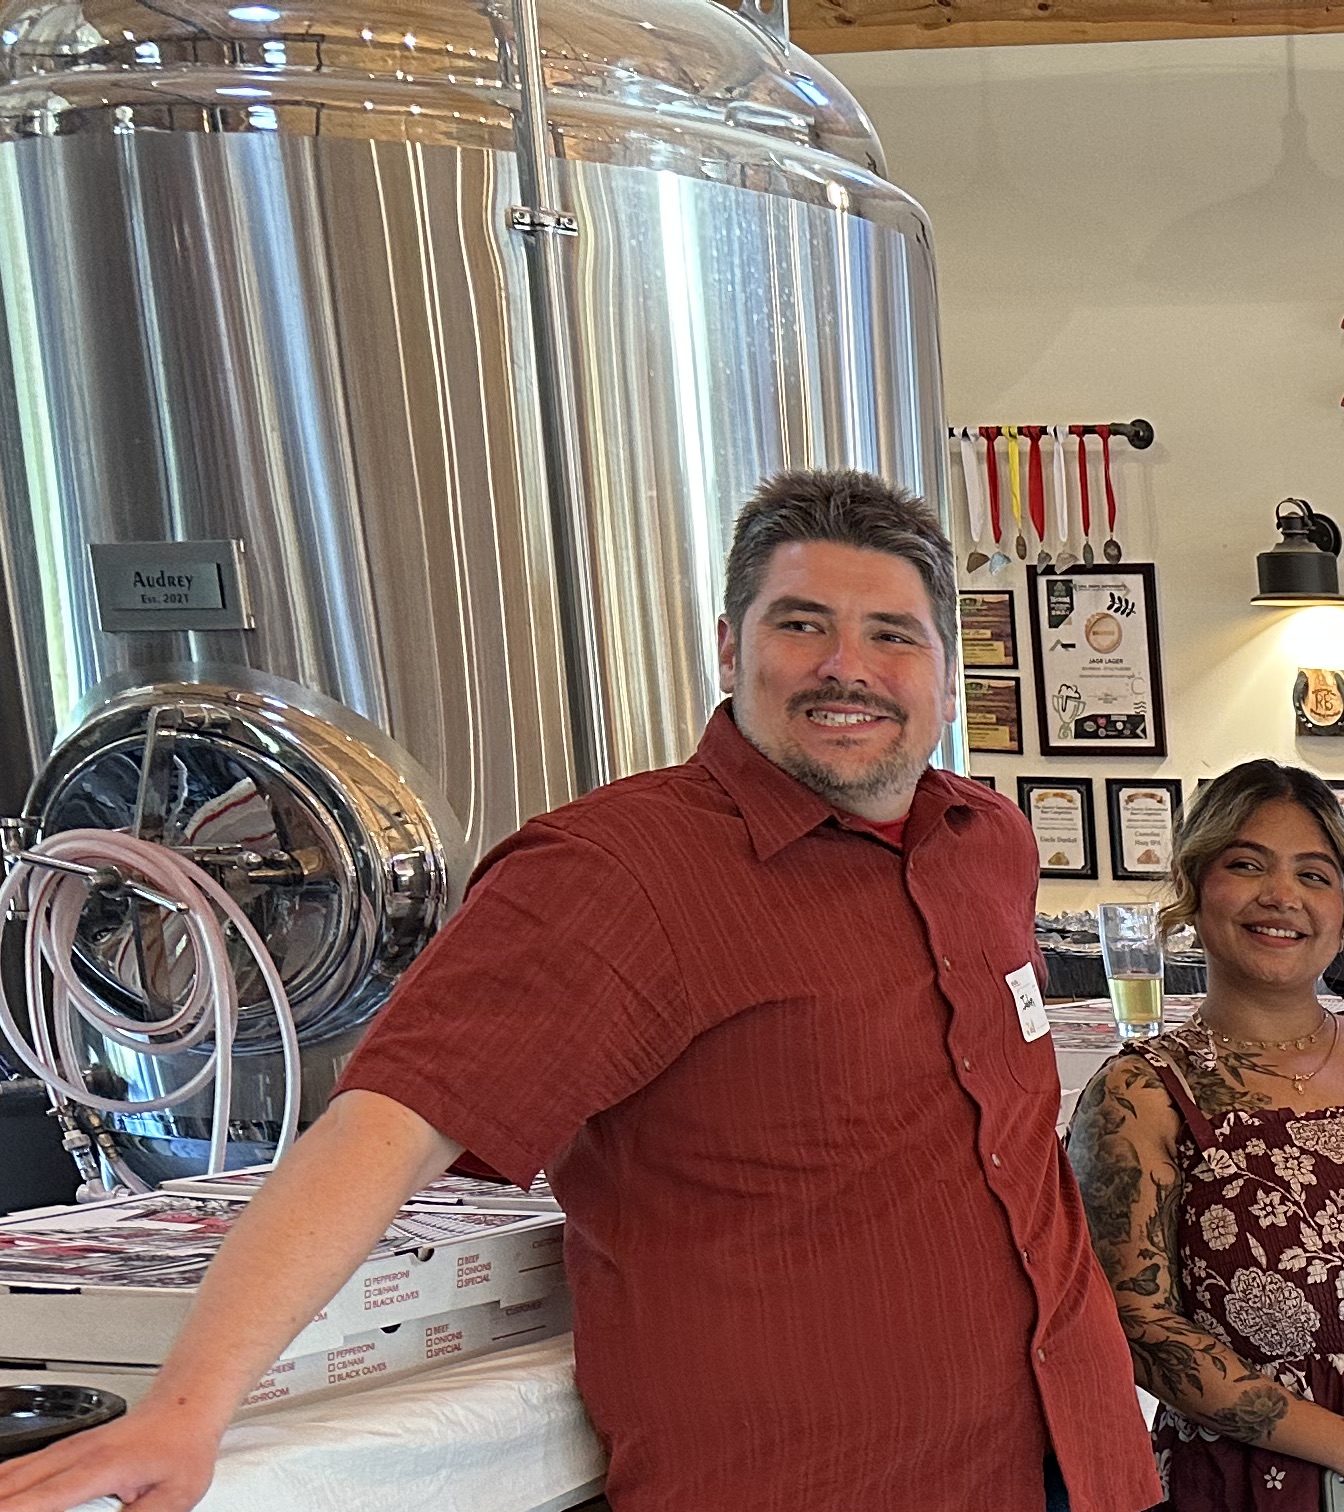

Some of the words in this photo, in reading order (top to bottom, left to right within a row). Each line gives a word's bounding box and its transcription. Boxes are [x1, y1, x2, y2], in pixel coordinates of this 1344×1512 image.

[163, 593, 189, 604] 2021
[464, 1253, 480, 1265] BEEF
[464, 1262, 492, 1276] ONIONS
[372, 1270, 410, 1285] PEPPERONI
[463, 1274, 491, 1288] SPECIAL
[372, 1296, 396, 1309] BLACK
[396, 1289, 420, 1304] OLIVES
[433, 1323, 450, 1335] BEEF
[433, 1331, 463, 1346] ONIONS
[336, 1343, 376, 1359] PEPPERONI
[433, 1343, 463, 1358] SPECIAL
[337, 1368, 361, 1383] BLACK
[362, 1362, 387, 1376] OLIVES
